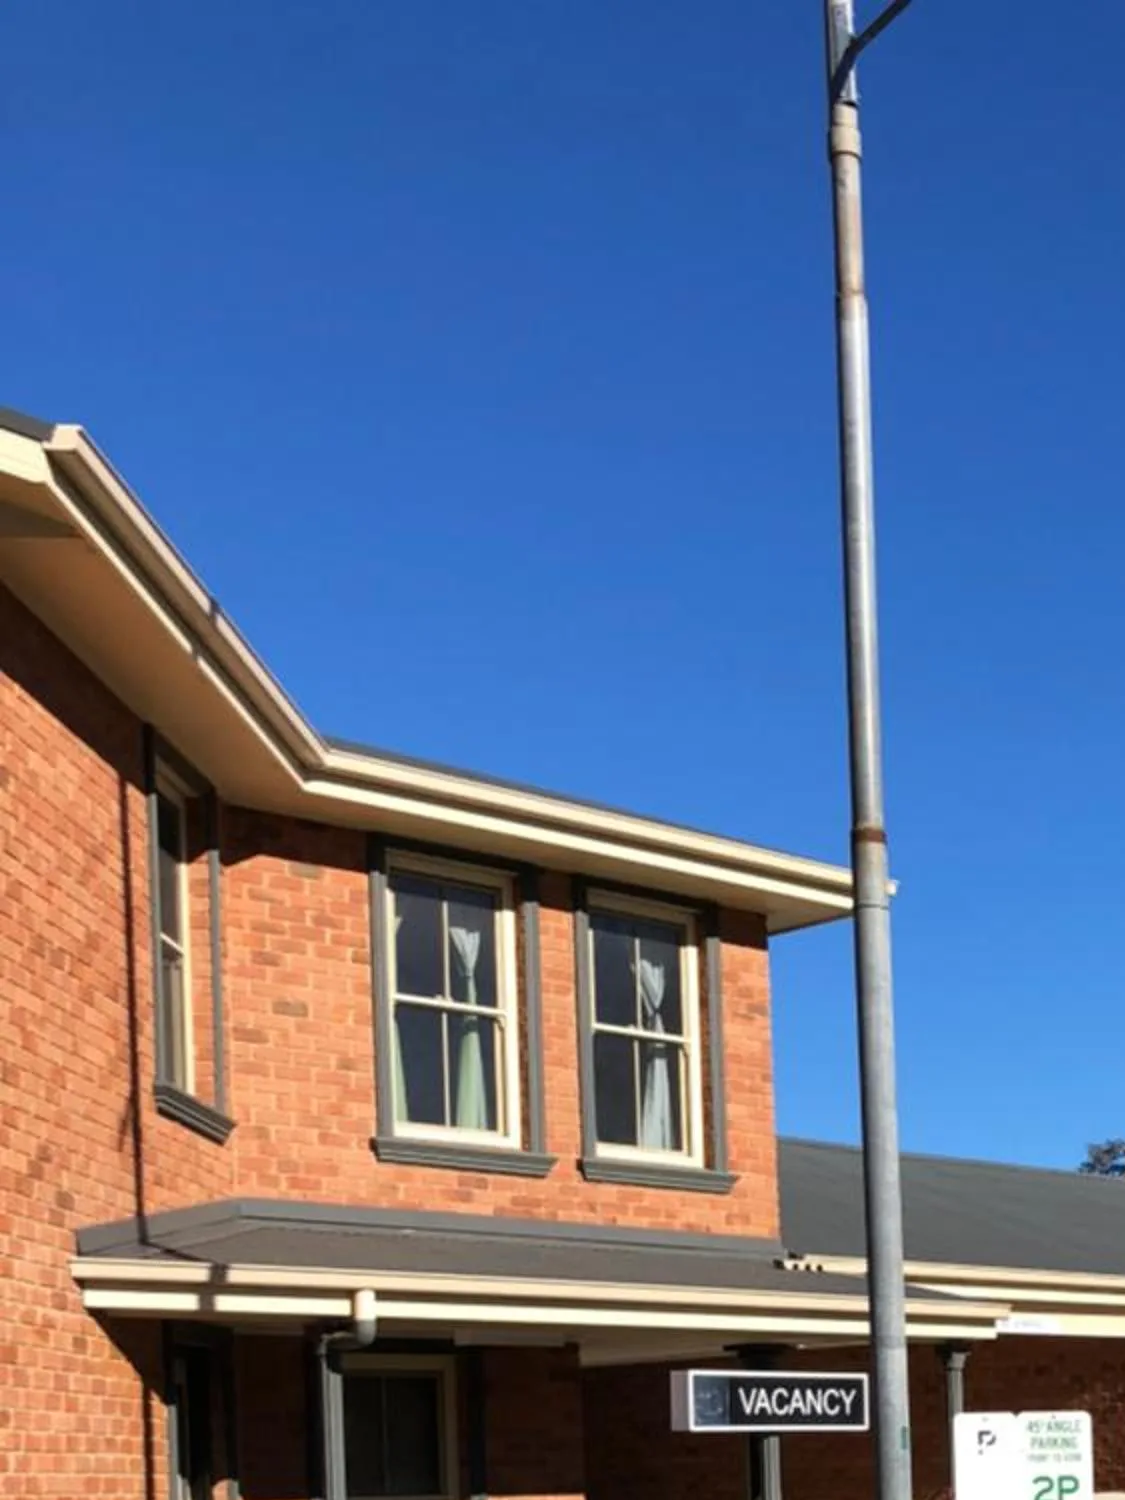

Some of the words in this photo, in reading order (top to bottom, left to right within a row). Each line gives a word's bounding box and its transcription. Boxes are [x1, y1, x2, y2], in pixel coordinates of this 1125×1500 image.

[738, 1387, 857, 1416] VACANCY
[1046, 1419, 1082, 1433] ANGLE
[1030, 1436, 1078, 1449] PARKING
